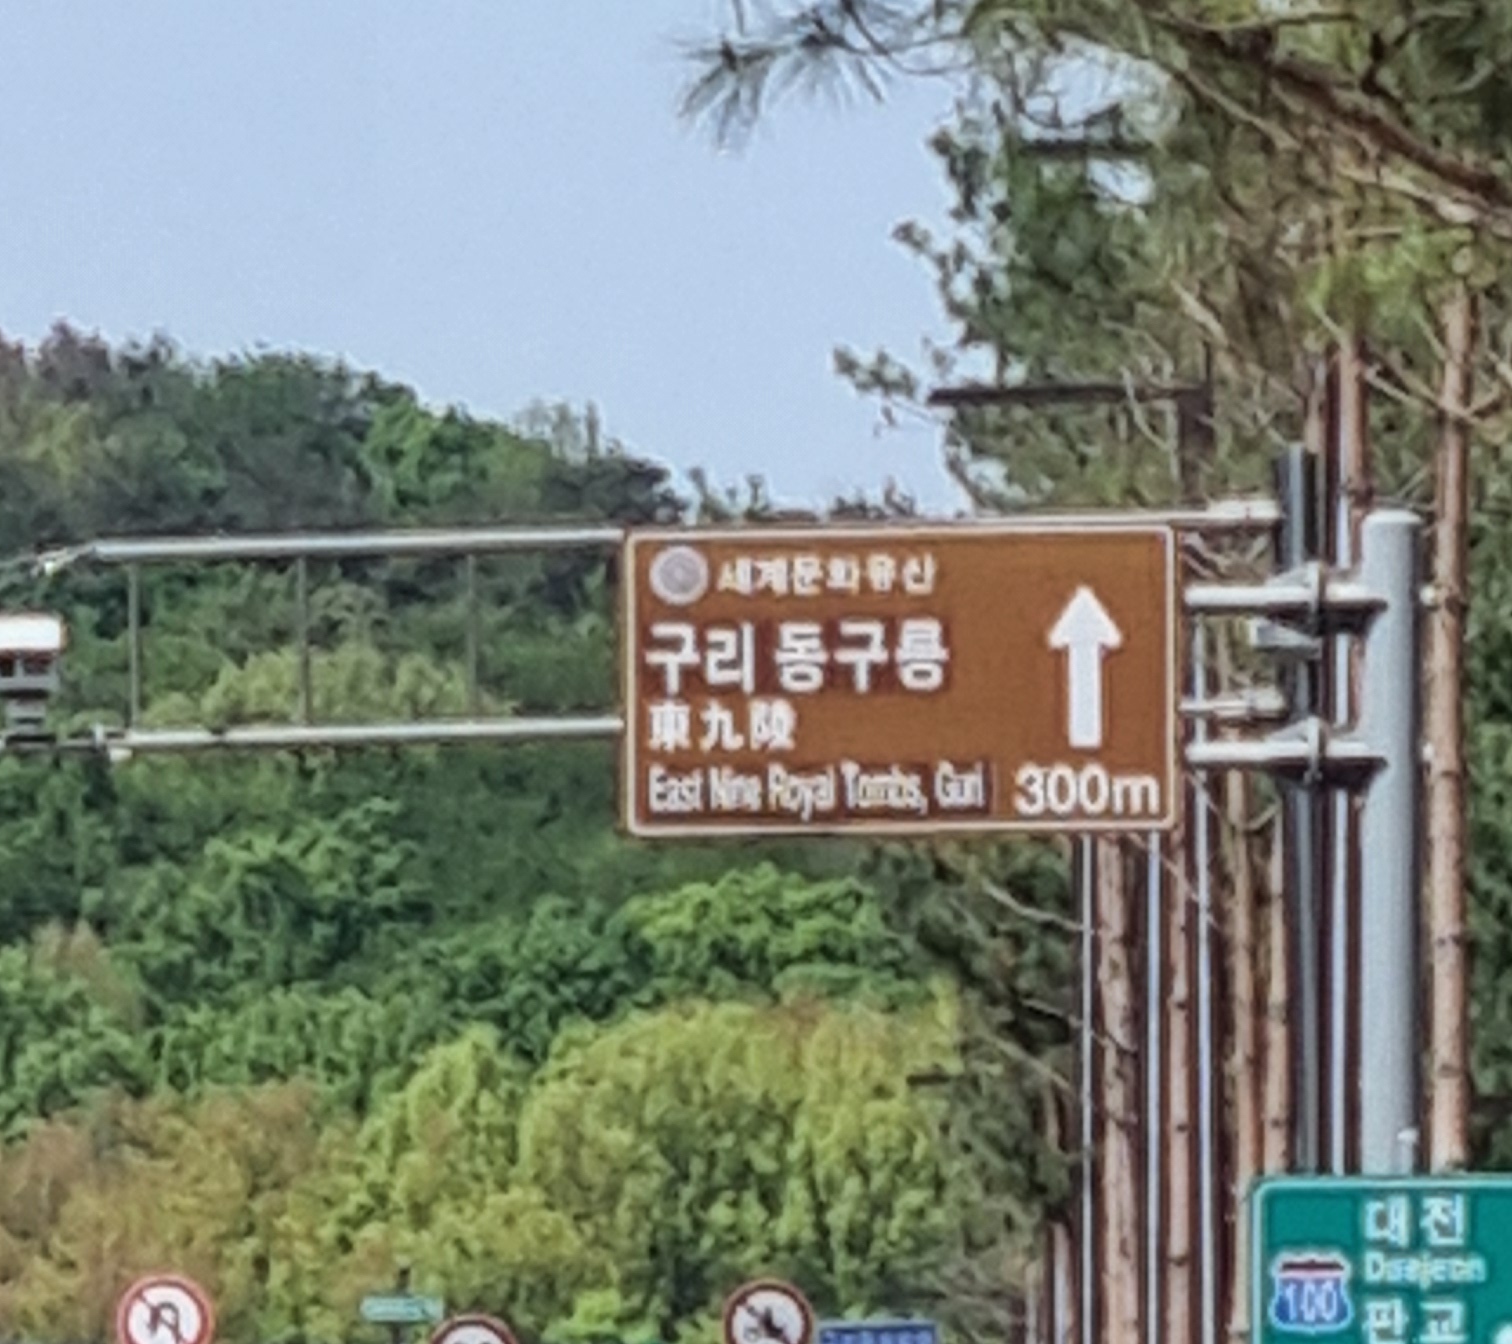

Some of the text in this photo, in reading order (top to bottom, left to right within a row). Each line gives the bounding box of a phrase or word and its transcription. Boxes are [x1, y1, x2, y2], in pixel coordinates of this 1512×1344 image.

[645, 617, 950, 695] 구리 동구릉
[648, 763, 704, 813] East
[767, 761, 836, 821] Royal
[1013, 763, 1160, 816] 300m
[1364, 1193, 1465, 1248] 대전
